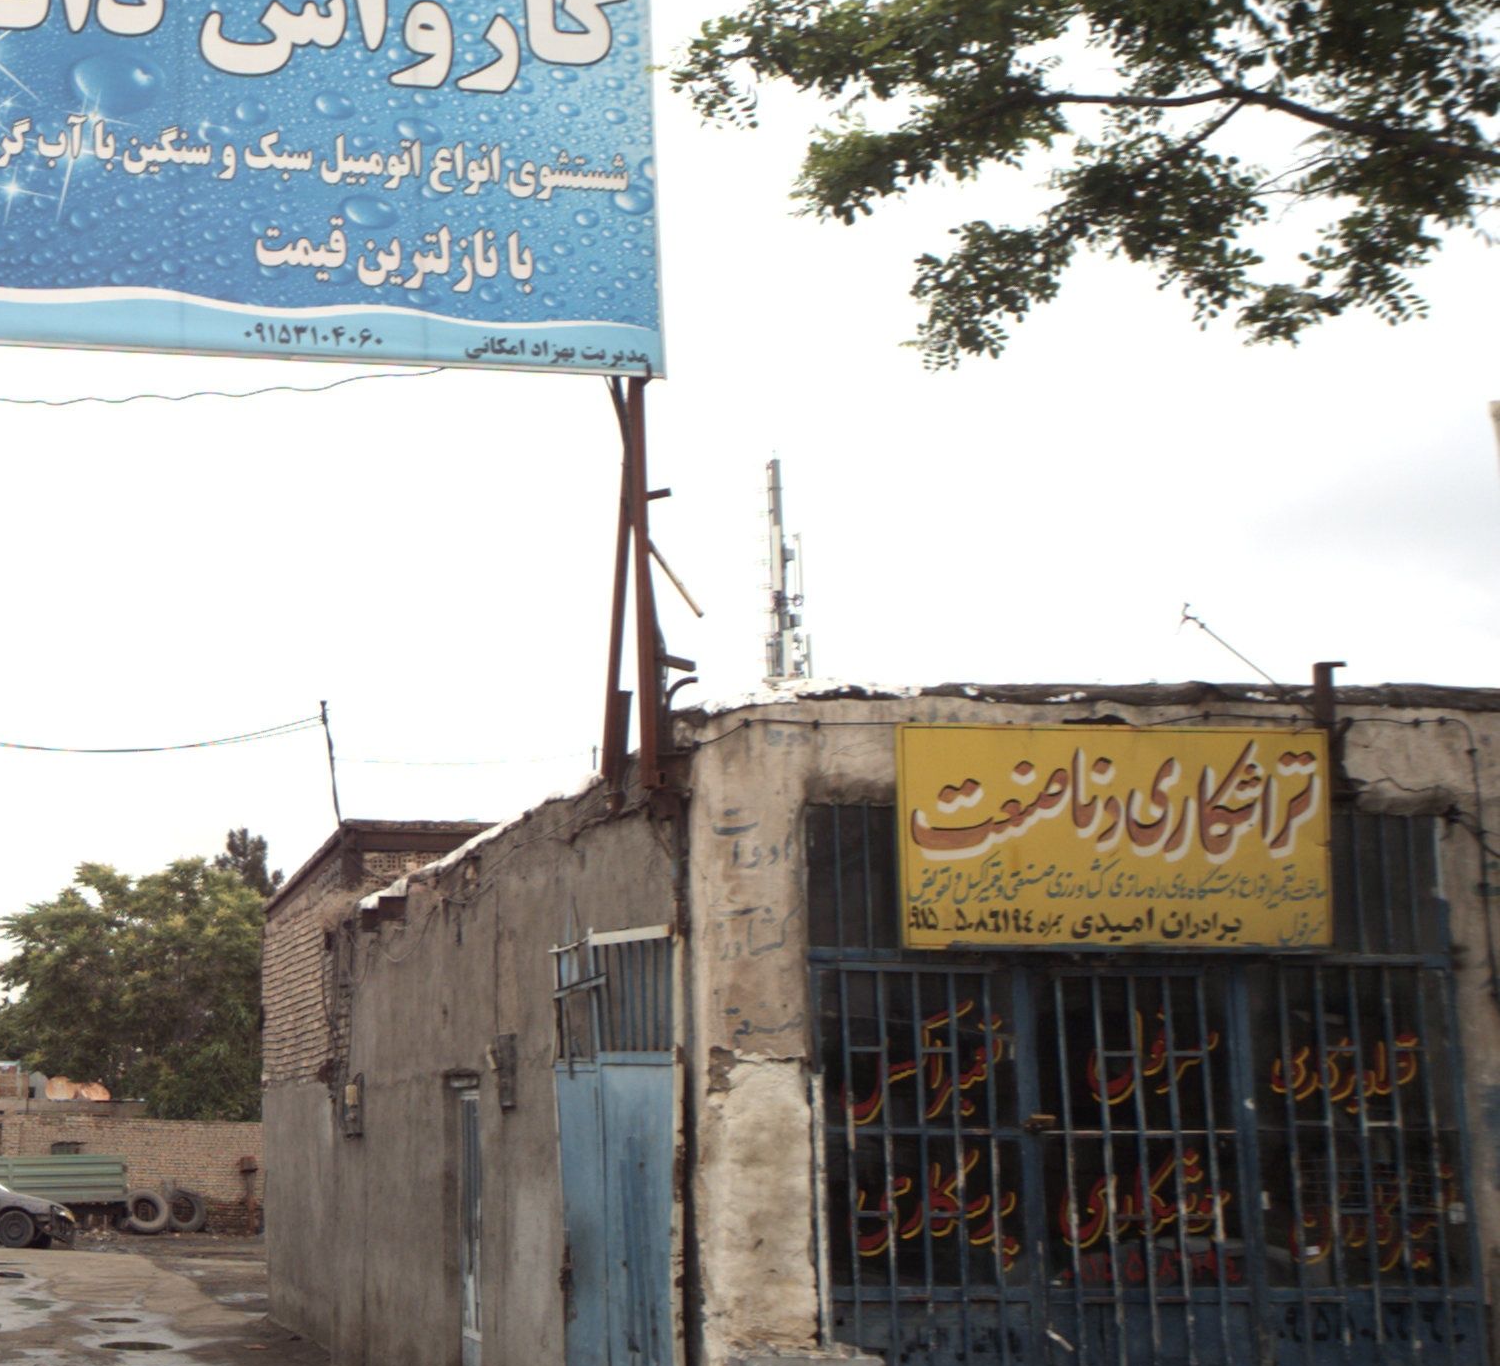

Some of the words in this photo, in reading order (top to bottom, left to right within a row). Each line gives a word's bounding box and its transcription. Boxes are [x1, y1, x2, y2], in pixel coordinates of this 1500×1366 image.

[37, 113, 87, 168] آب
[92, 119, 116, 172] با
[122, 124, 213, 175] سنگین
[217, 144, 237, 180] و
[244, 131, 314, 182] سبک
[320, 133, 423, 190] اتومبیل
[429, 141, 502, 196] انواع
[507, 149, 630, 201] شستشوی
[254, 215, 348, 283] قیمت
[507, 230, 536, 294] با
[243, 322, 384, 349] ۰۹۱۵۳۱۰۴۰۶۰
[530, 339, 577, 365] بهزاد
[581, 343, 651, 368] مدیریت
[910, 758, 1071, 860] صنعت
[1126, 738, 1322, 864] تراشکاری
[1071, 906, 1155, 940] امیدی
[1160, 911, 1243, 941] برادران
